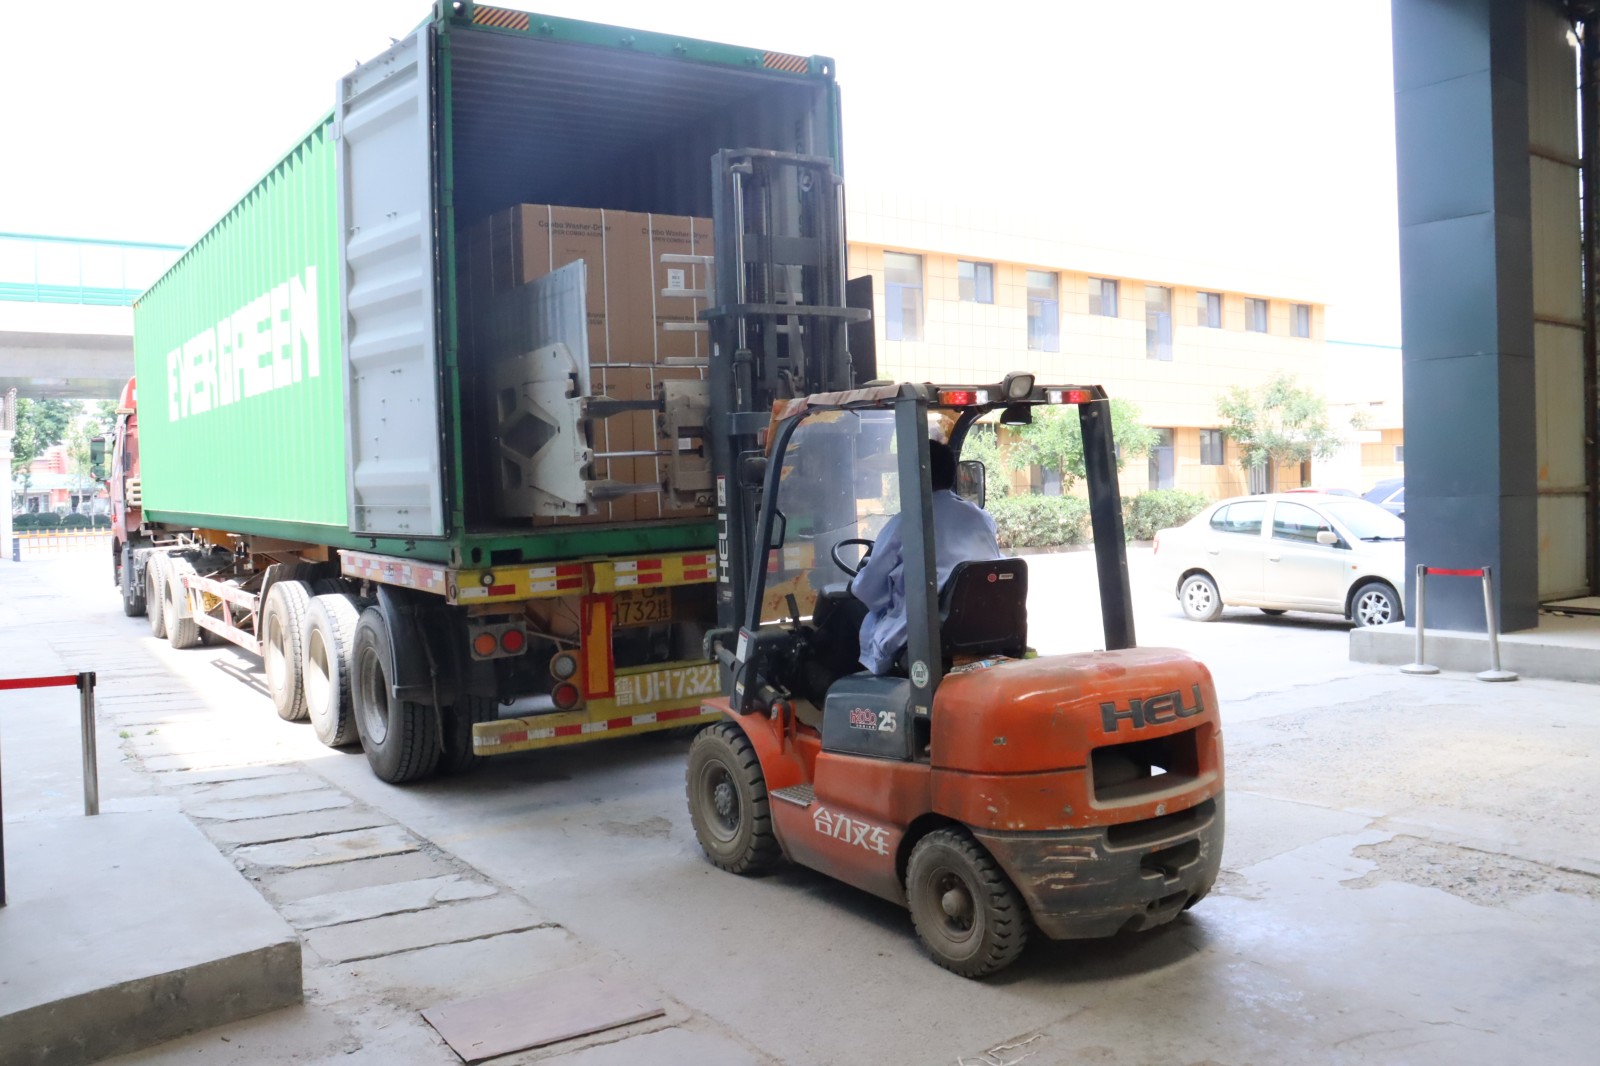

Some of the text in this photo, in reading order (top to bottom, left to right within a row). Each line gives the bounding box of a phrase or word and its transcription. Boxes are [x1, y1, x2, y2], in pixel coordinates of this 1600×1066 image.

[167, 265, 320, 422] EVERGREEN
[718, 513, 730, 583] HELI
[878, 710, 897, 732] 25
[1100, 683, 1204, 733] HELI
[813, 806, 890, 856] 合力叉车
